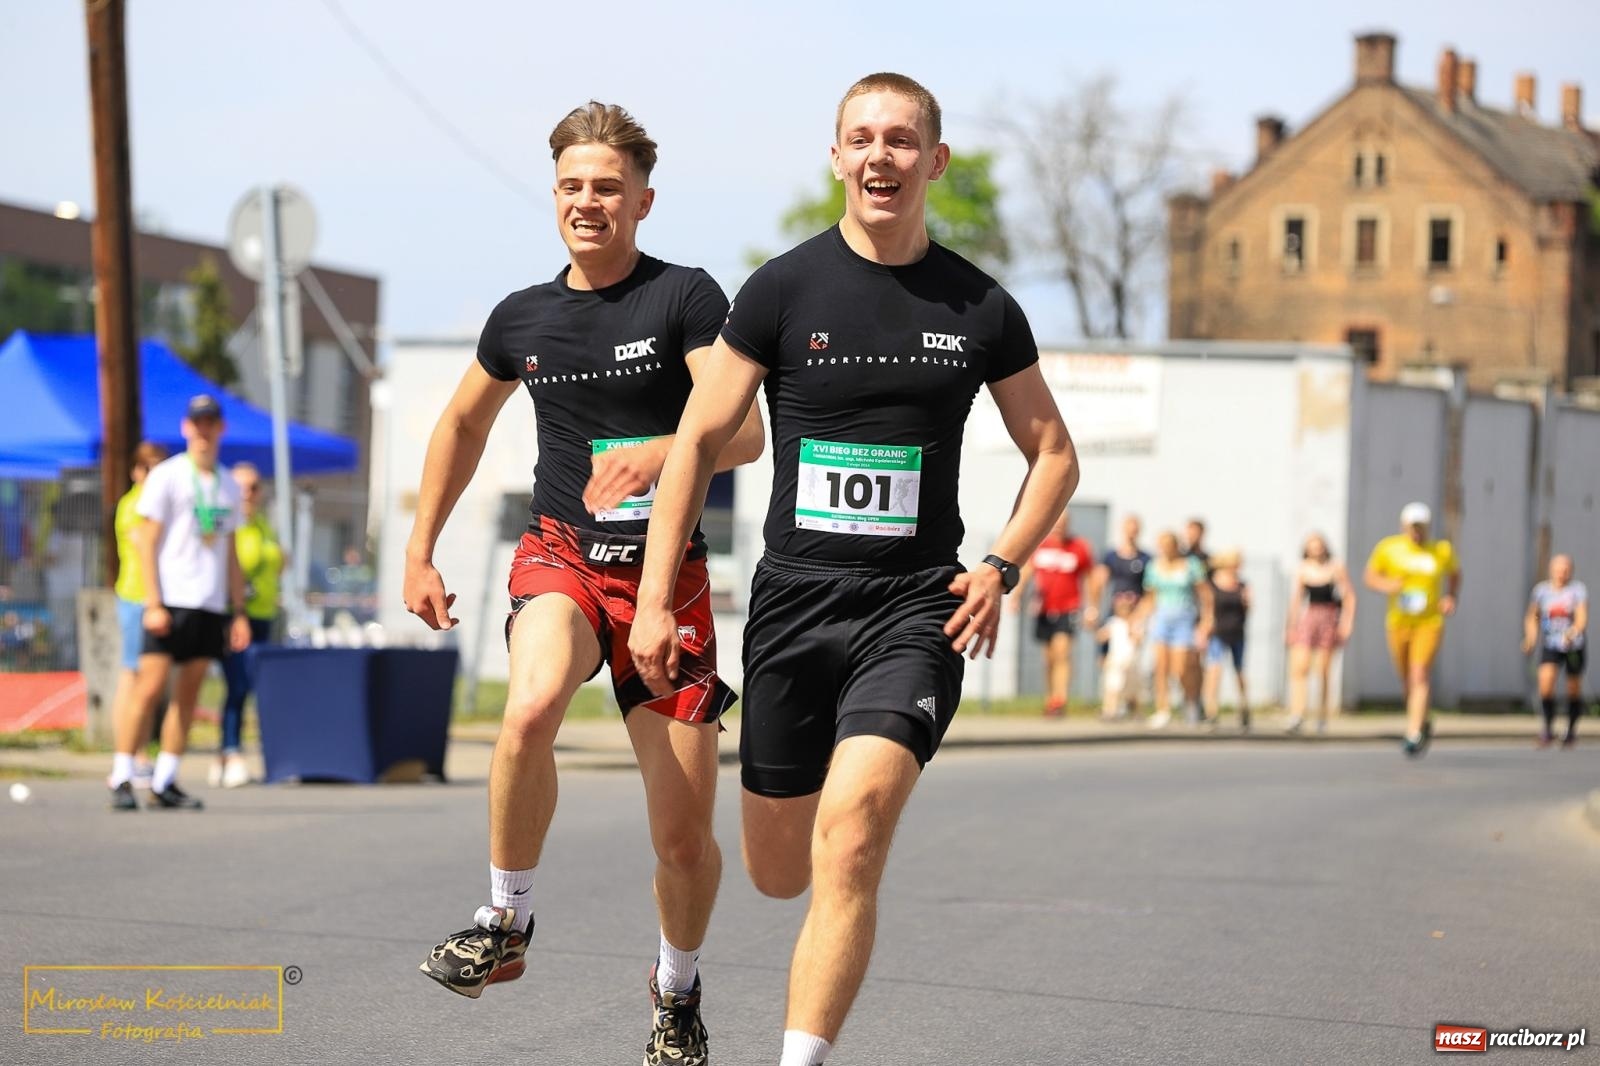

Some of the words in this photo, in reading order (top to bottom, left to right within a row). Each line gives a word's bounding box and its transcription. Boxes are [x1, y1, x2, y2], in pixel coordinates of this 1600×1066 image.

[806, 356, 899, 366] SPORTOWA
[910, 356, 968, 368] POLSKA
[528, 372, 599, 386] SPORTOWA
[606, 361, 662, 377] POLSKA
[812, 445, 828, 454] XVI
[830, 446, 850, 454] BIEG
[852, 448, 870, 456] BEZ
[870, 449, 908, 458] GRANIC
[827, 472, 890, 511] 101
[589, 542, 638, 563] UFC
